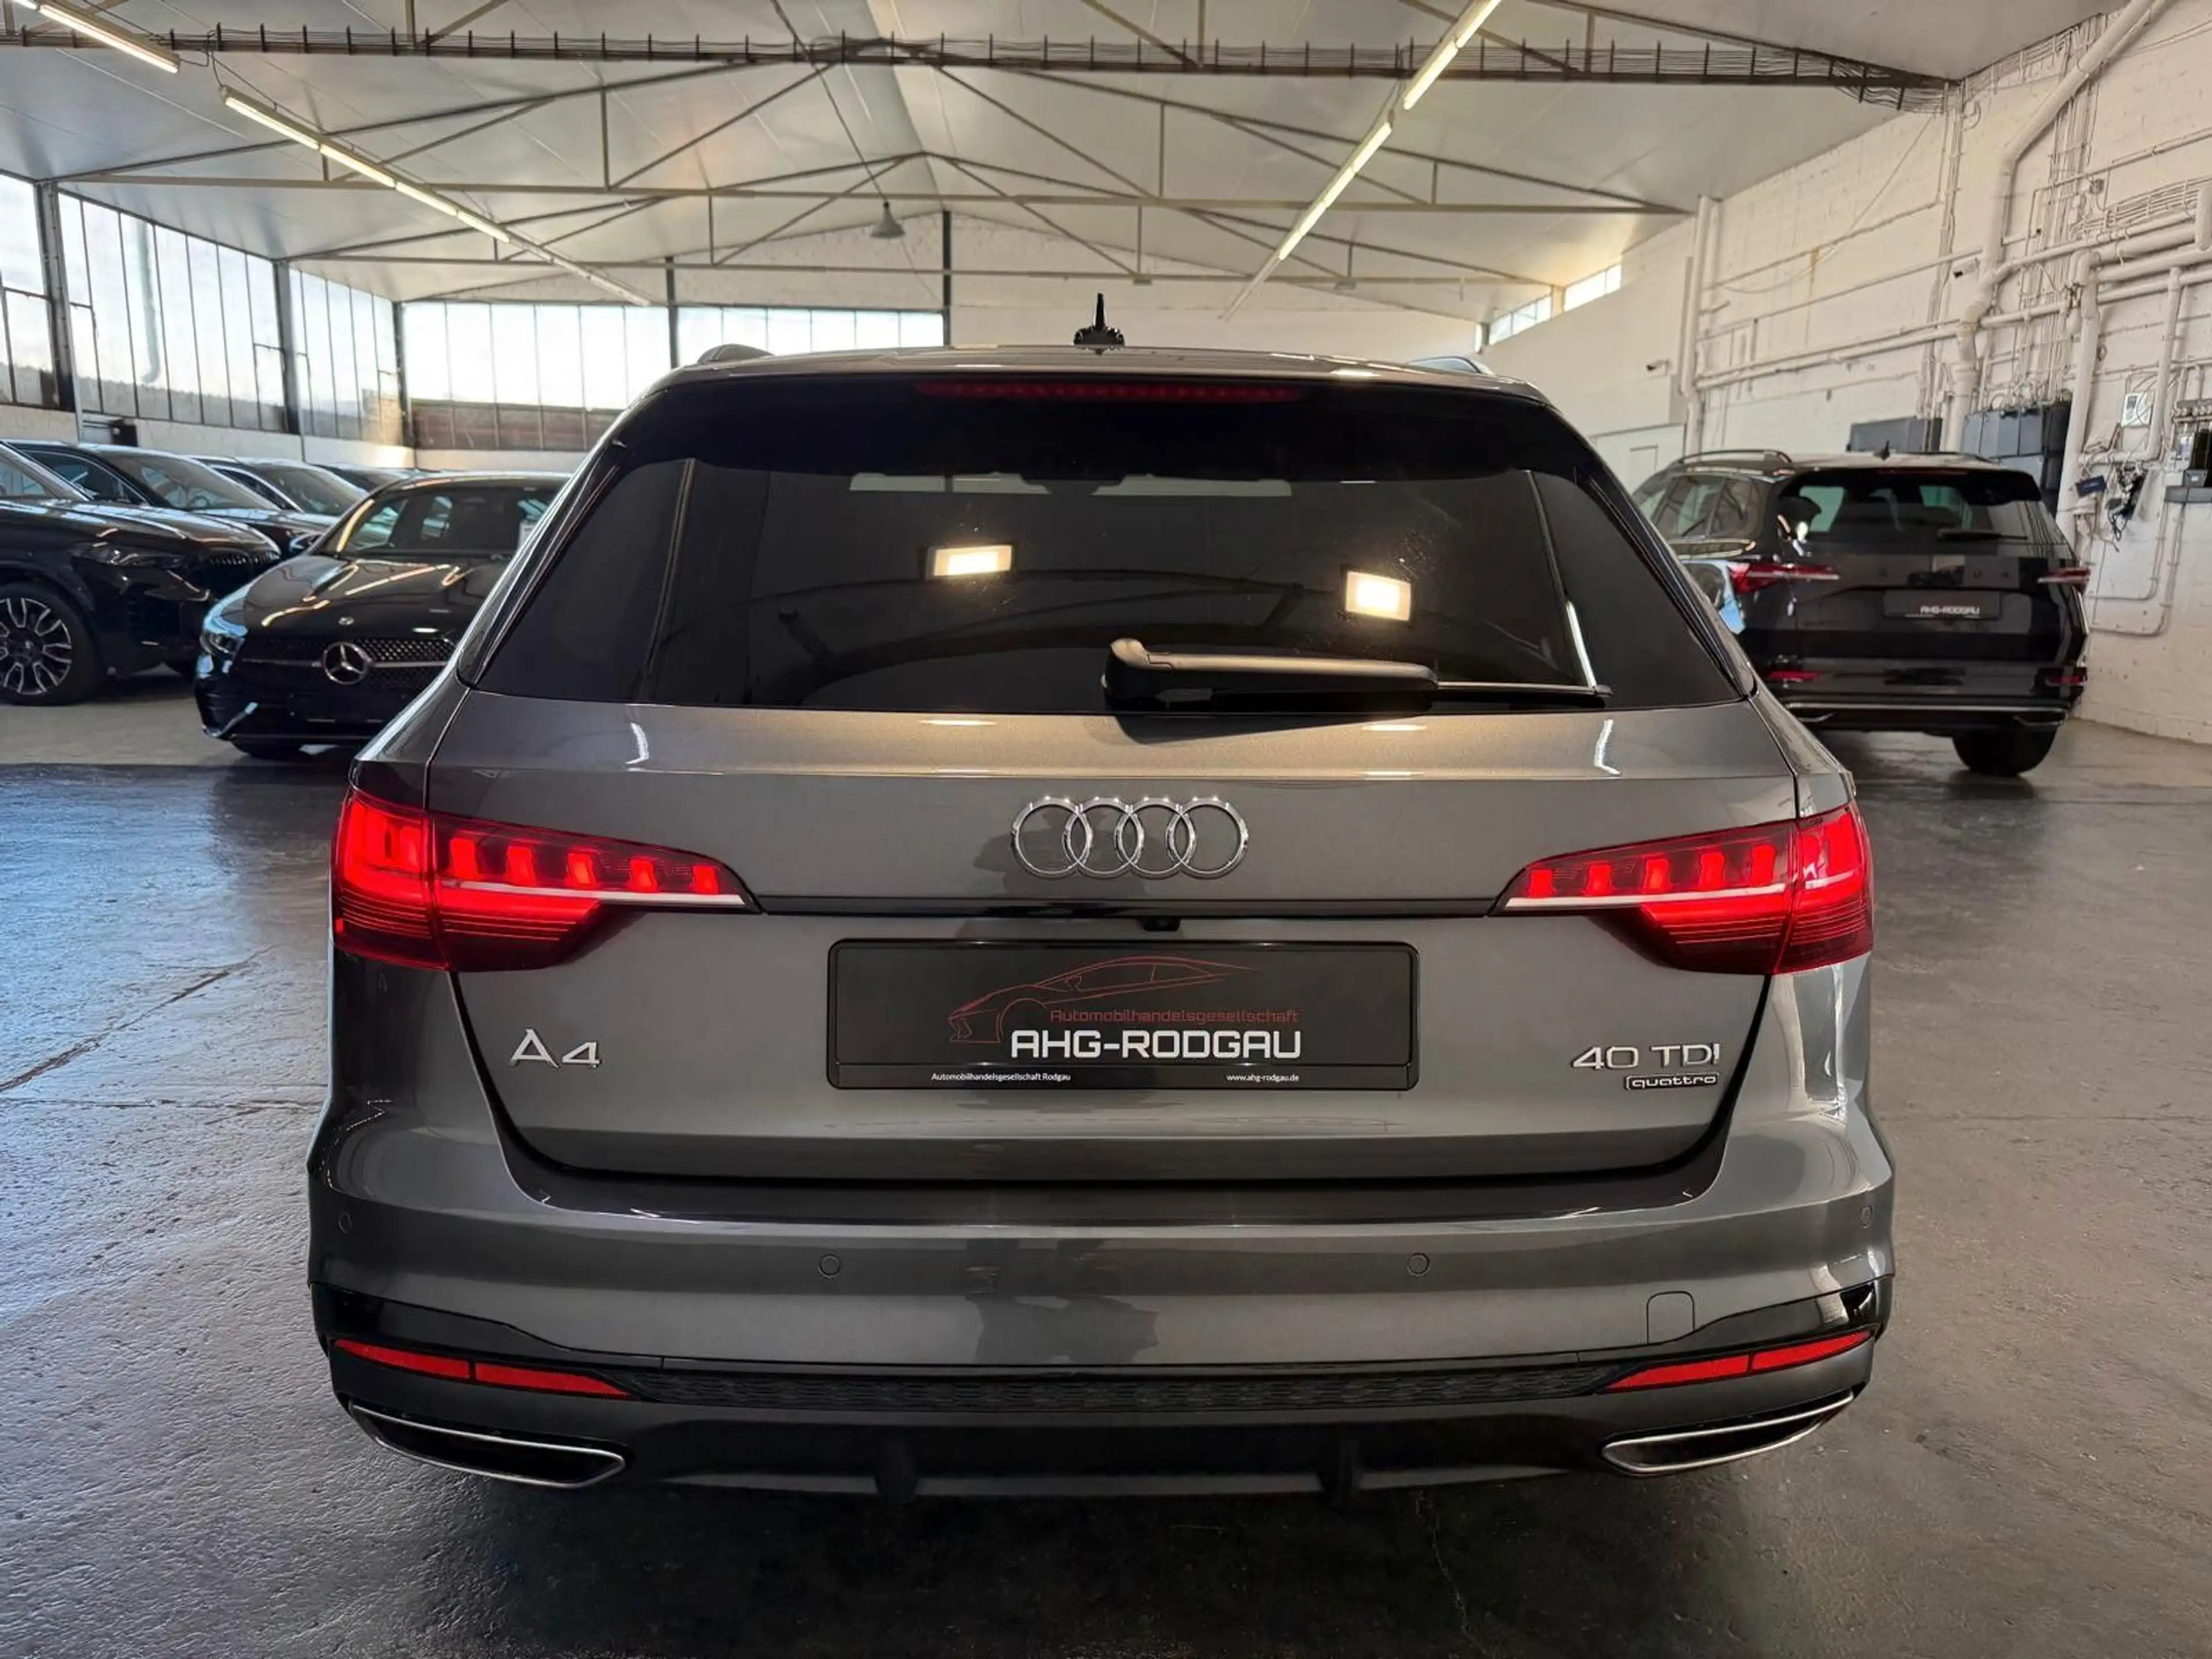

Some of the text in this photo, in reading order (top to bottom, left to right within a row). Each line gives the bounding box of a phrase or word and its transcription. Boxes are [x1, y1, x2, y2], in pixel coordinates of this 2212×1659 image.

[1051, 1009, 1299, 1025] Automobilhandelsgesellschaft
[509, 1028, 600, 1069] A4
[1011, 1030, 1301, 1058] AHG-RODGAU
[1571, 1044, 1720, 1070] 40 TDI
[931, 1073, 1071, 1082] Automobilhandelsgesellschaft Rodgau
[1226, 1073, 1300, 1083] www.ahg-rodgau.de
[1632, 1075, 1717, 1089] quattro
